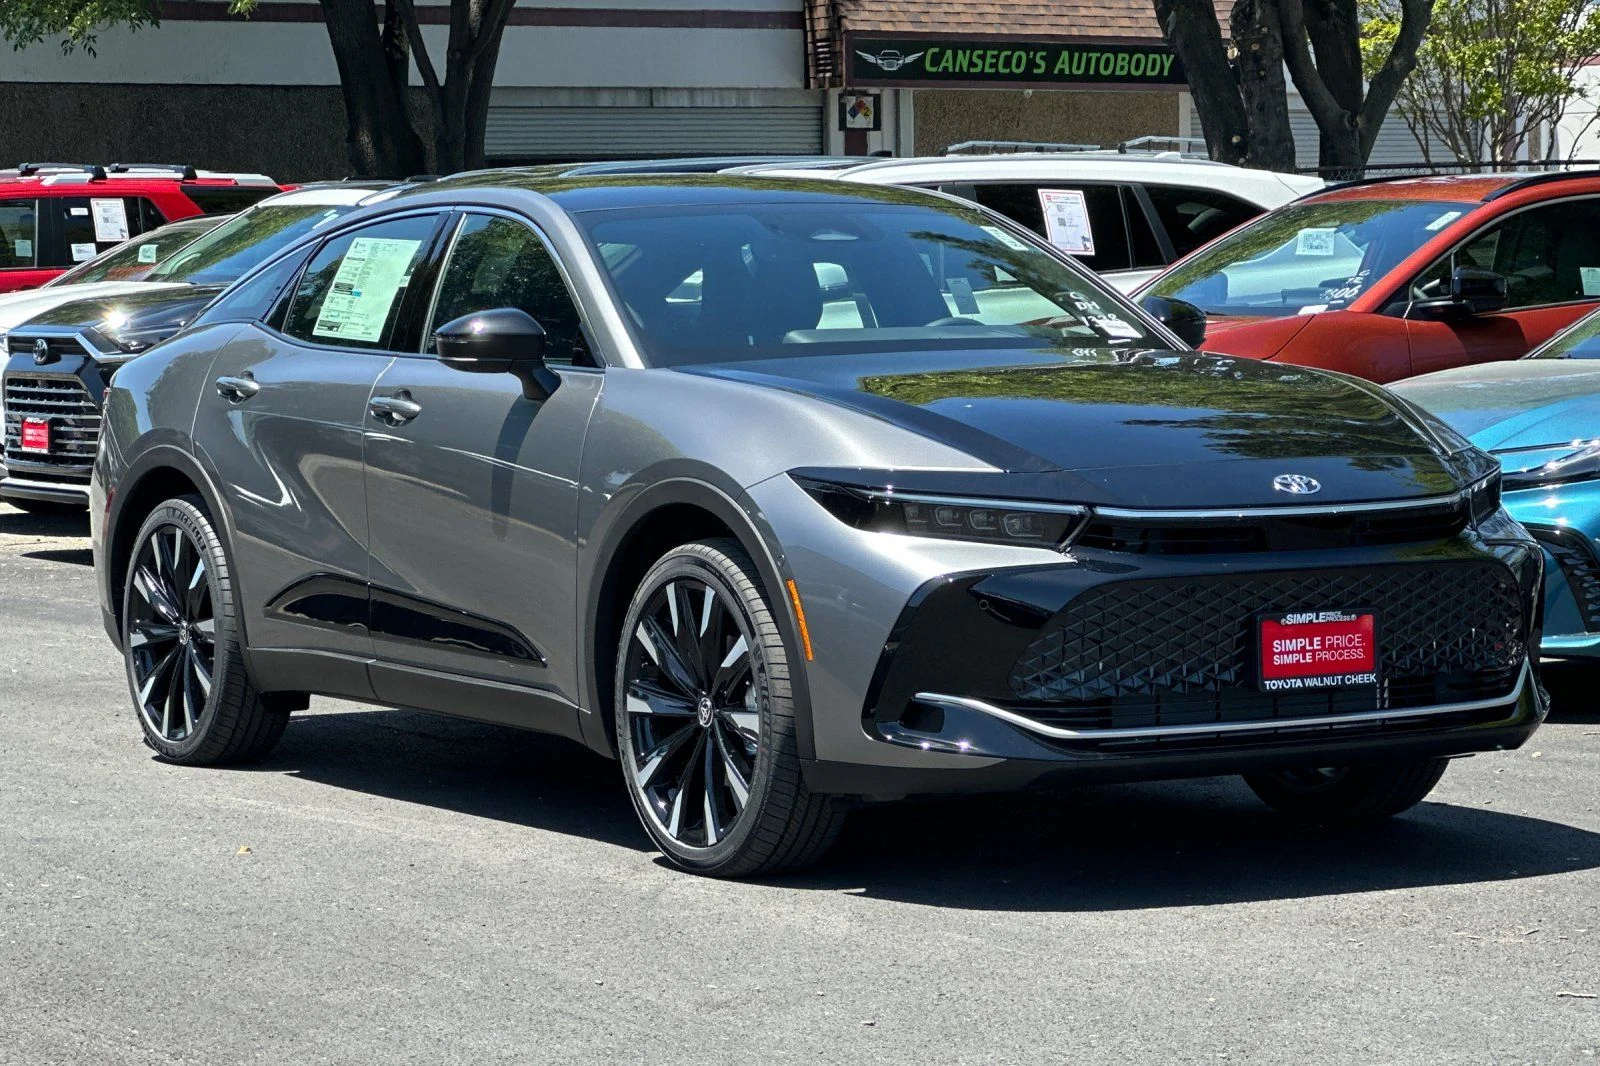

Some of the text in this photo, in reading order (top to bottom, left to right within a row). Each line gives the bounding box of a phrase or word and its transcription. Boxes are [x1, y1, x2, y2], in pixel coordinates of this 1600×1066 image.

[924, 47, 1175, 76] CANSECO'S AUTOBODY
[1285, 612, 1326, 625] SIMPLE
[1272, 634, 1366, 652] SIMPLE PRICE.
[1273, 649, 1366, 665] SIMPLE PROCESS.
[1264, 679, 1303, 690] TOYOTA
[1304, 676, 1343, 687] WALNUT
